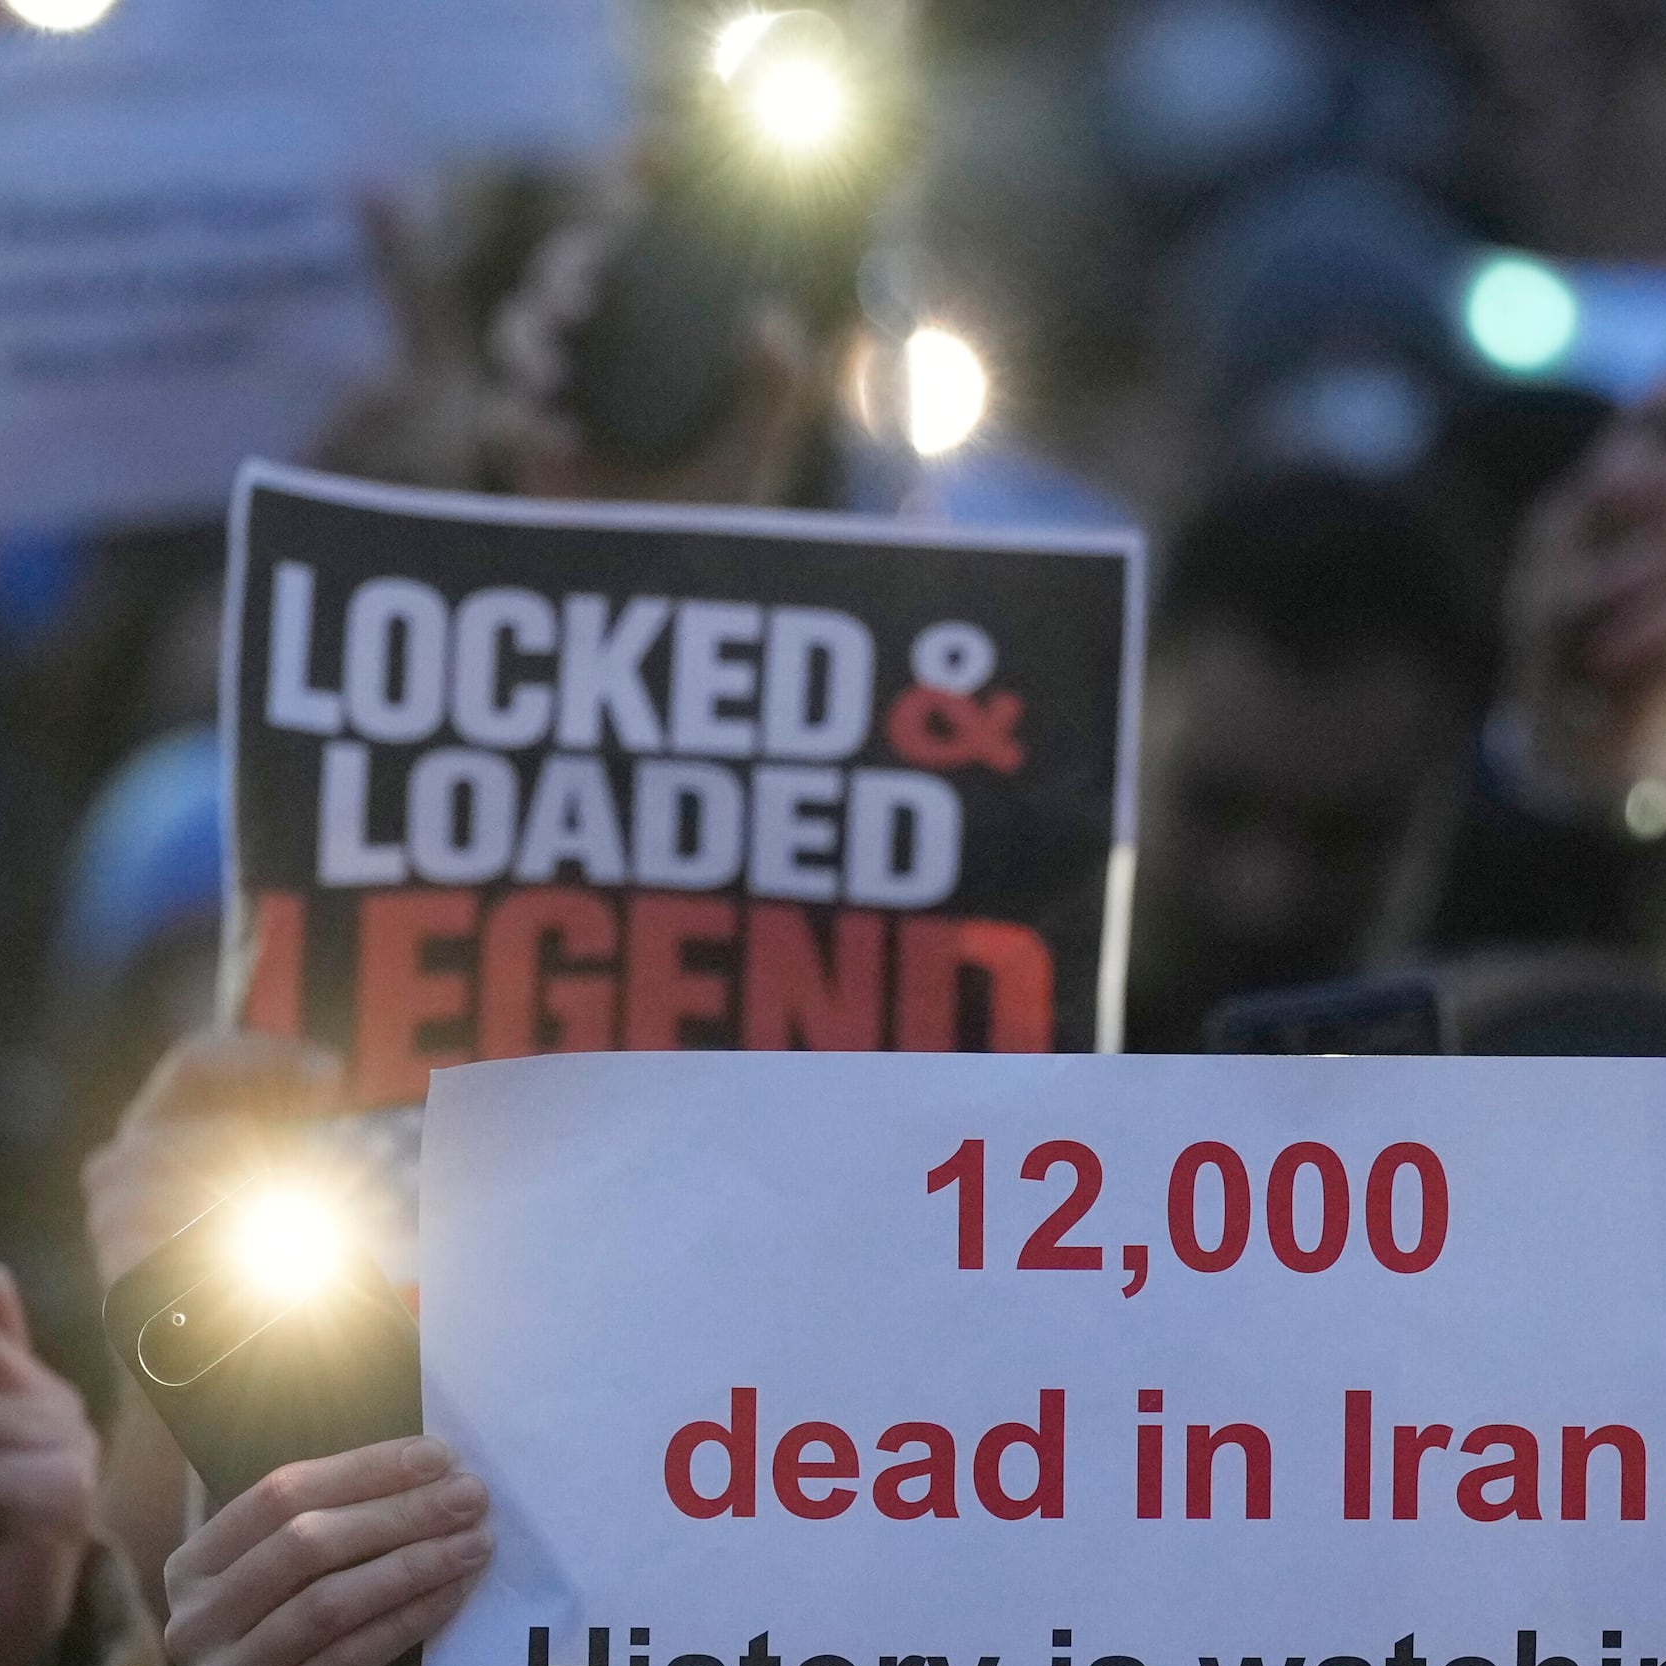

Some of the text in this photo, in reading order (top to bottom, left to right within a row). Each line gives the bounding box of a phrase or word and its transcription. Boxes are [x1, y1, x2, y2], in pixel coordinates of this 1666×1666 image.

[266, 560, 877, 762] LOCKED
[317, 742, 963, 908] LOADED
[925, 1138, 1450, 1299] 12,000
[664, 1387, 1067, 1521] dead
[1137, 1389, 1272, 1521] in
